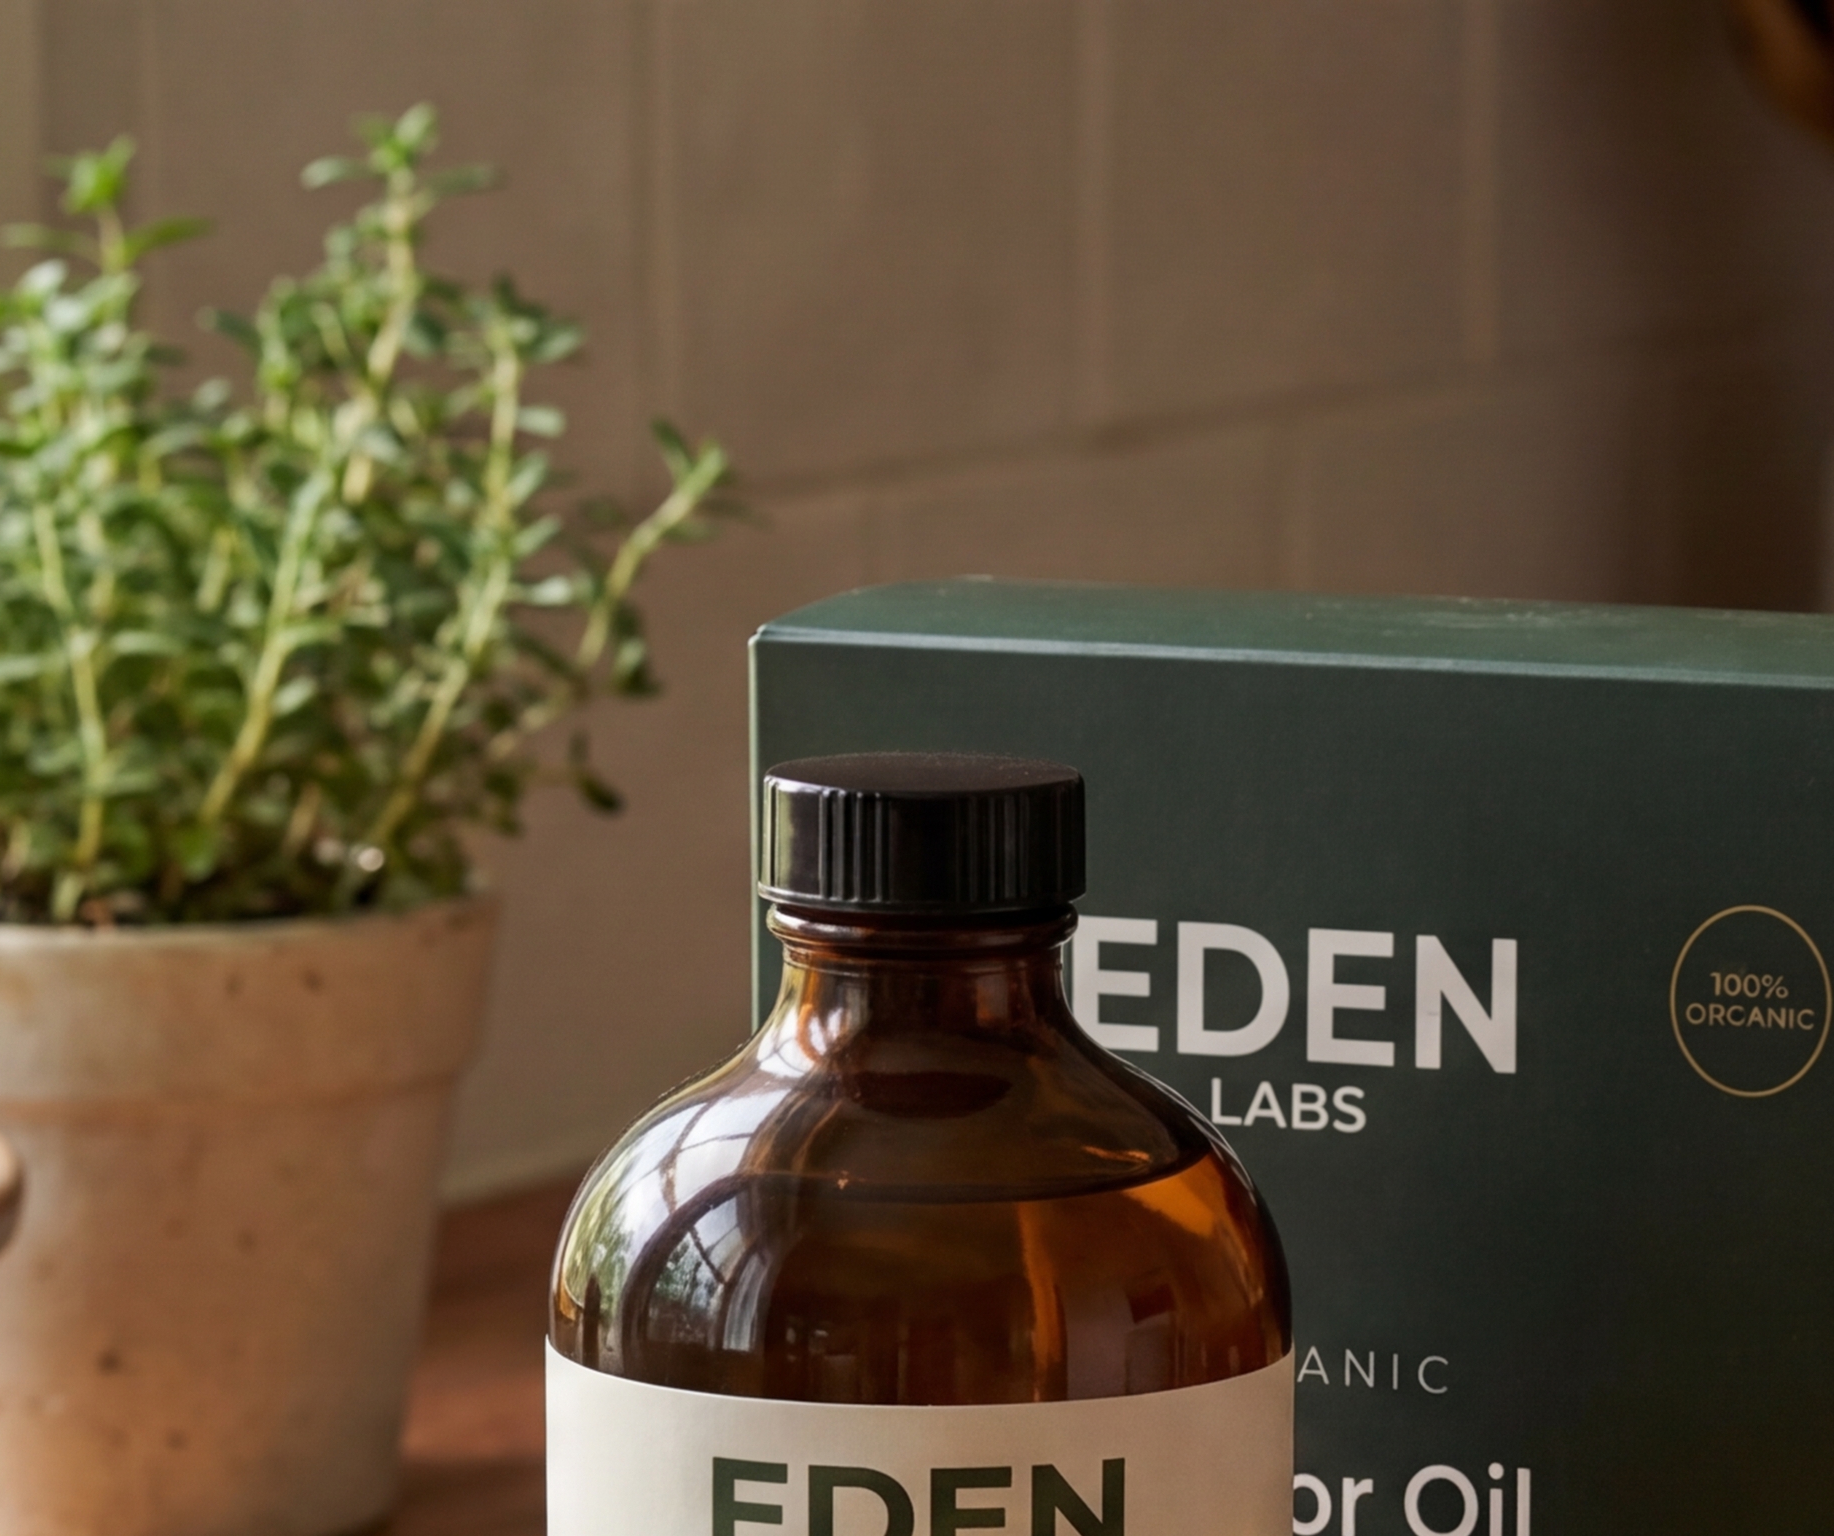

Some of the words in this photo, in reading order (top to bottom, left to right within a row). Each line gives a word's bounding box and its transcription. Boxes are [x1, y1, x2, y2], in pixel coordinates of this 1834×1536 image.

[1072, 914, 1517, 1075] EDEN
[1711, 972, 1788, 998] 100%
[1212, 1078, 1366, 1132] LABS
